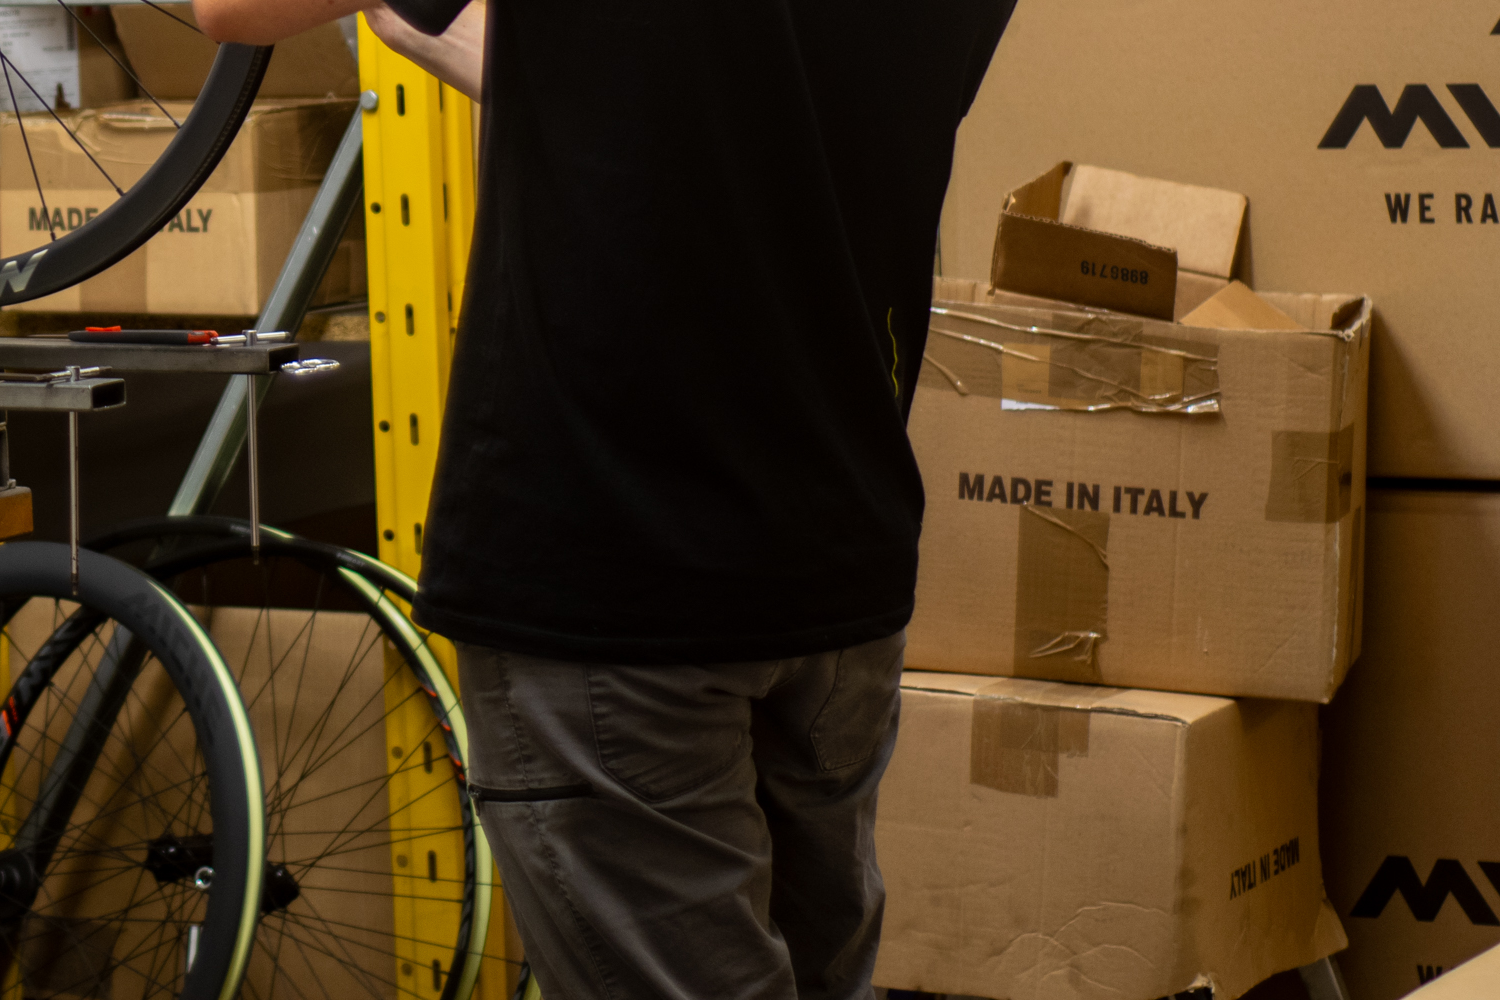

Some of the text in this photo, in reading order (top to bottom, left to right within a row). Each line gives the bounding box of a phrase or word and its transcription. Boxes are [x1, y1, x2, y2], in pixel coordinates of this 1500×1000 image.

[29, 207, 213, 233] MADE ALY
[1384, 193, 1500, 224] WE RA
[958, 472, 1209, 520] MADE IN ITALY
[1229, 836, 1300, 901] MADE IN ITALY
